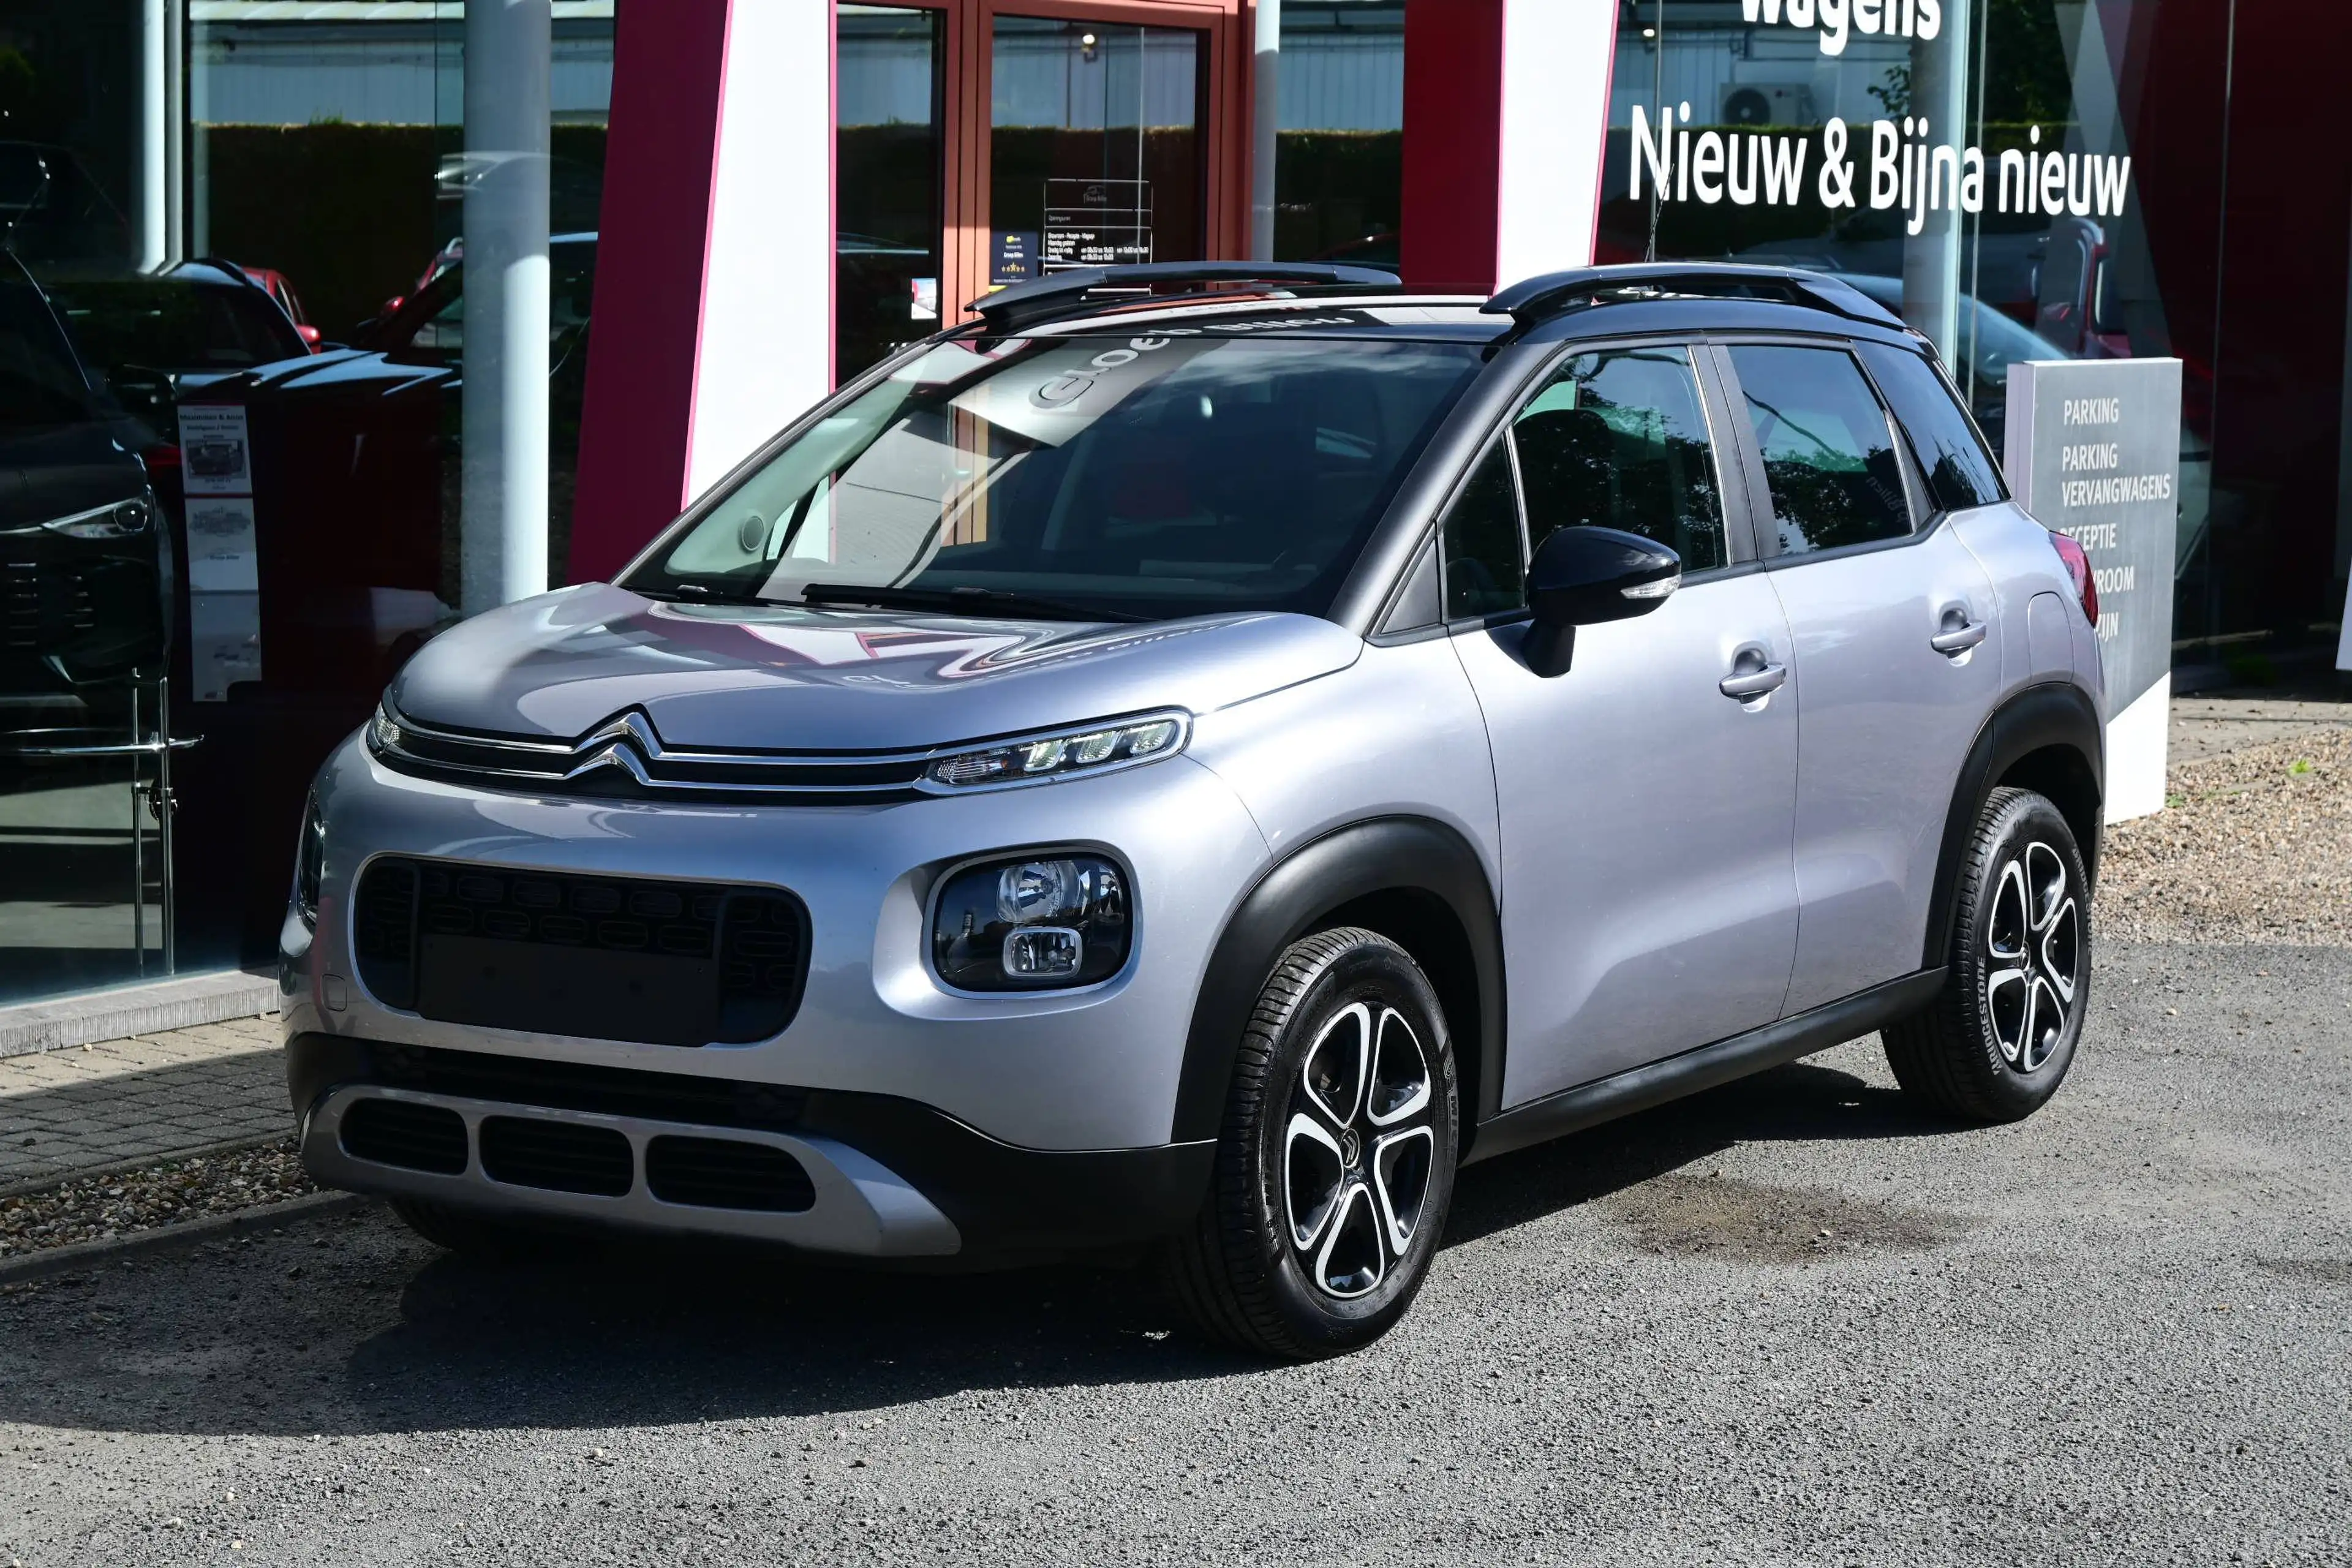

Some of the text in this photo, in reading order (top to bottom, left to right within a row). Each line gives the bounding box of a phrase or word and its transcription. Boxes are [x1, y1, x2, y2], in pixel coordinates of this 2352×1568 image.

[1629, 100, 2131, 236] Nieuw & Bijna nieuw
[2064, 398, 2119, 426] PARKING
[2062, 443, 2118, 472] PARKING
[2062, 473, 2171, 507] VERVANGWAGENS
[2060, 524, 2116, 551] CEPTIE
[2092, 566, 2134, 594] ROOM
[2095, 612, 2119, 643] ZIJN
[1977, 956, 2003, 1076] BRIDGESTONE
